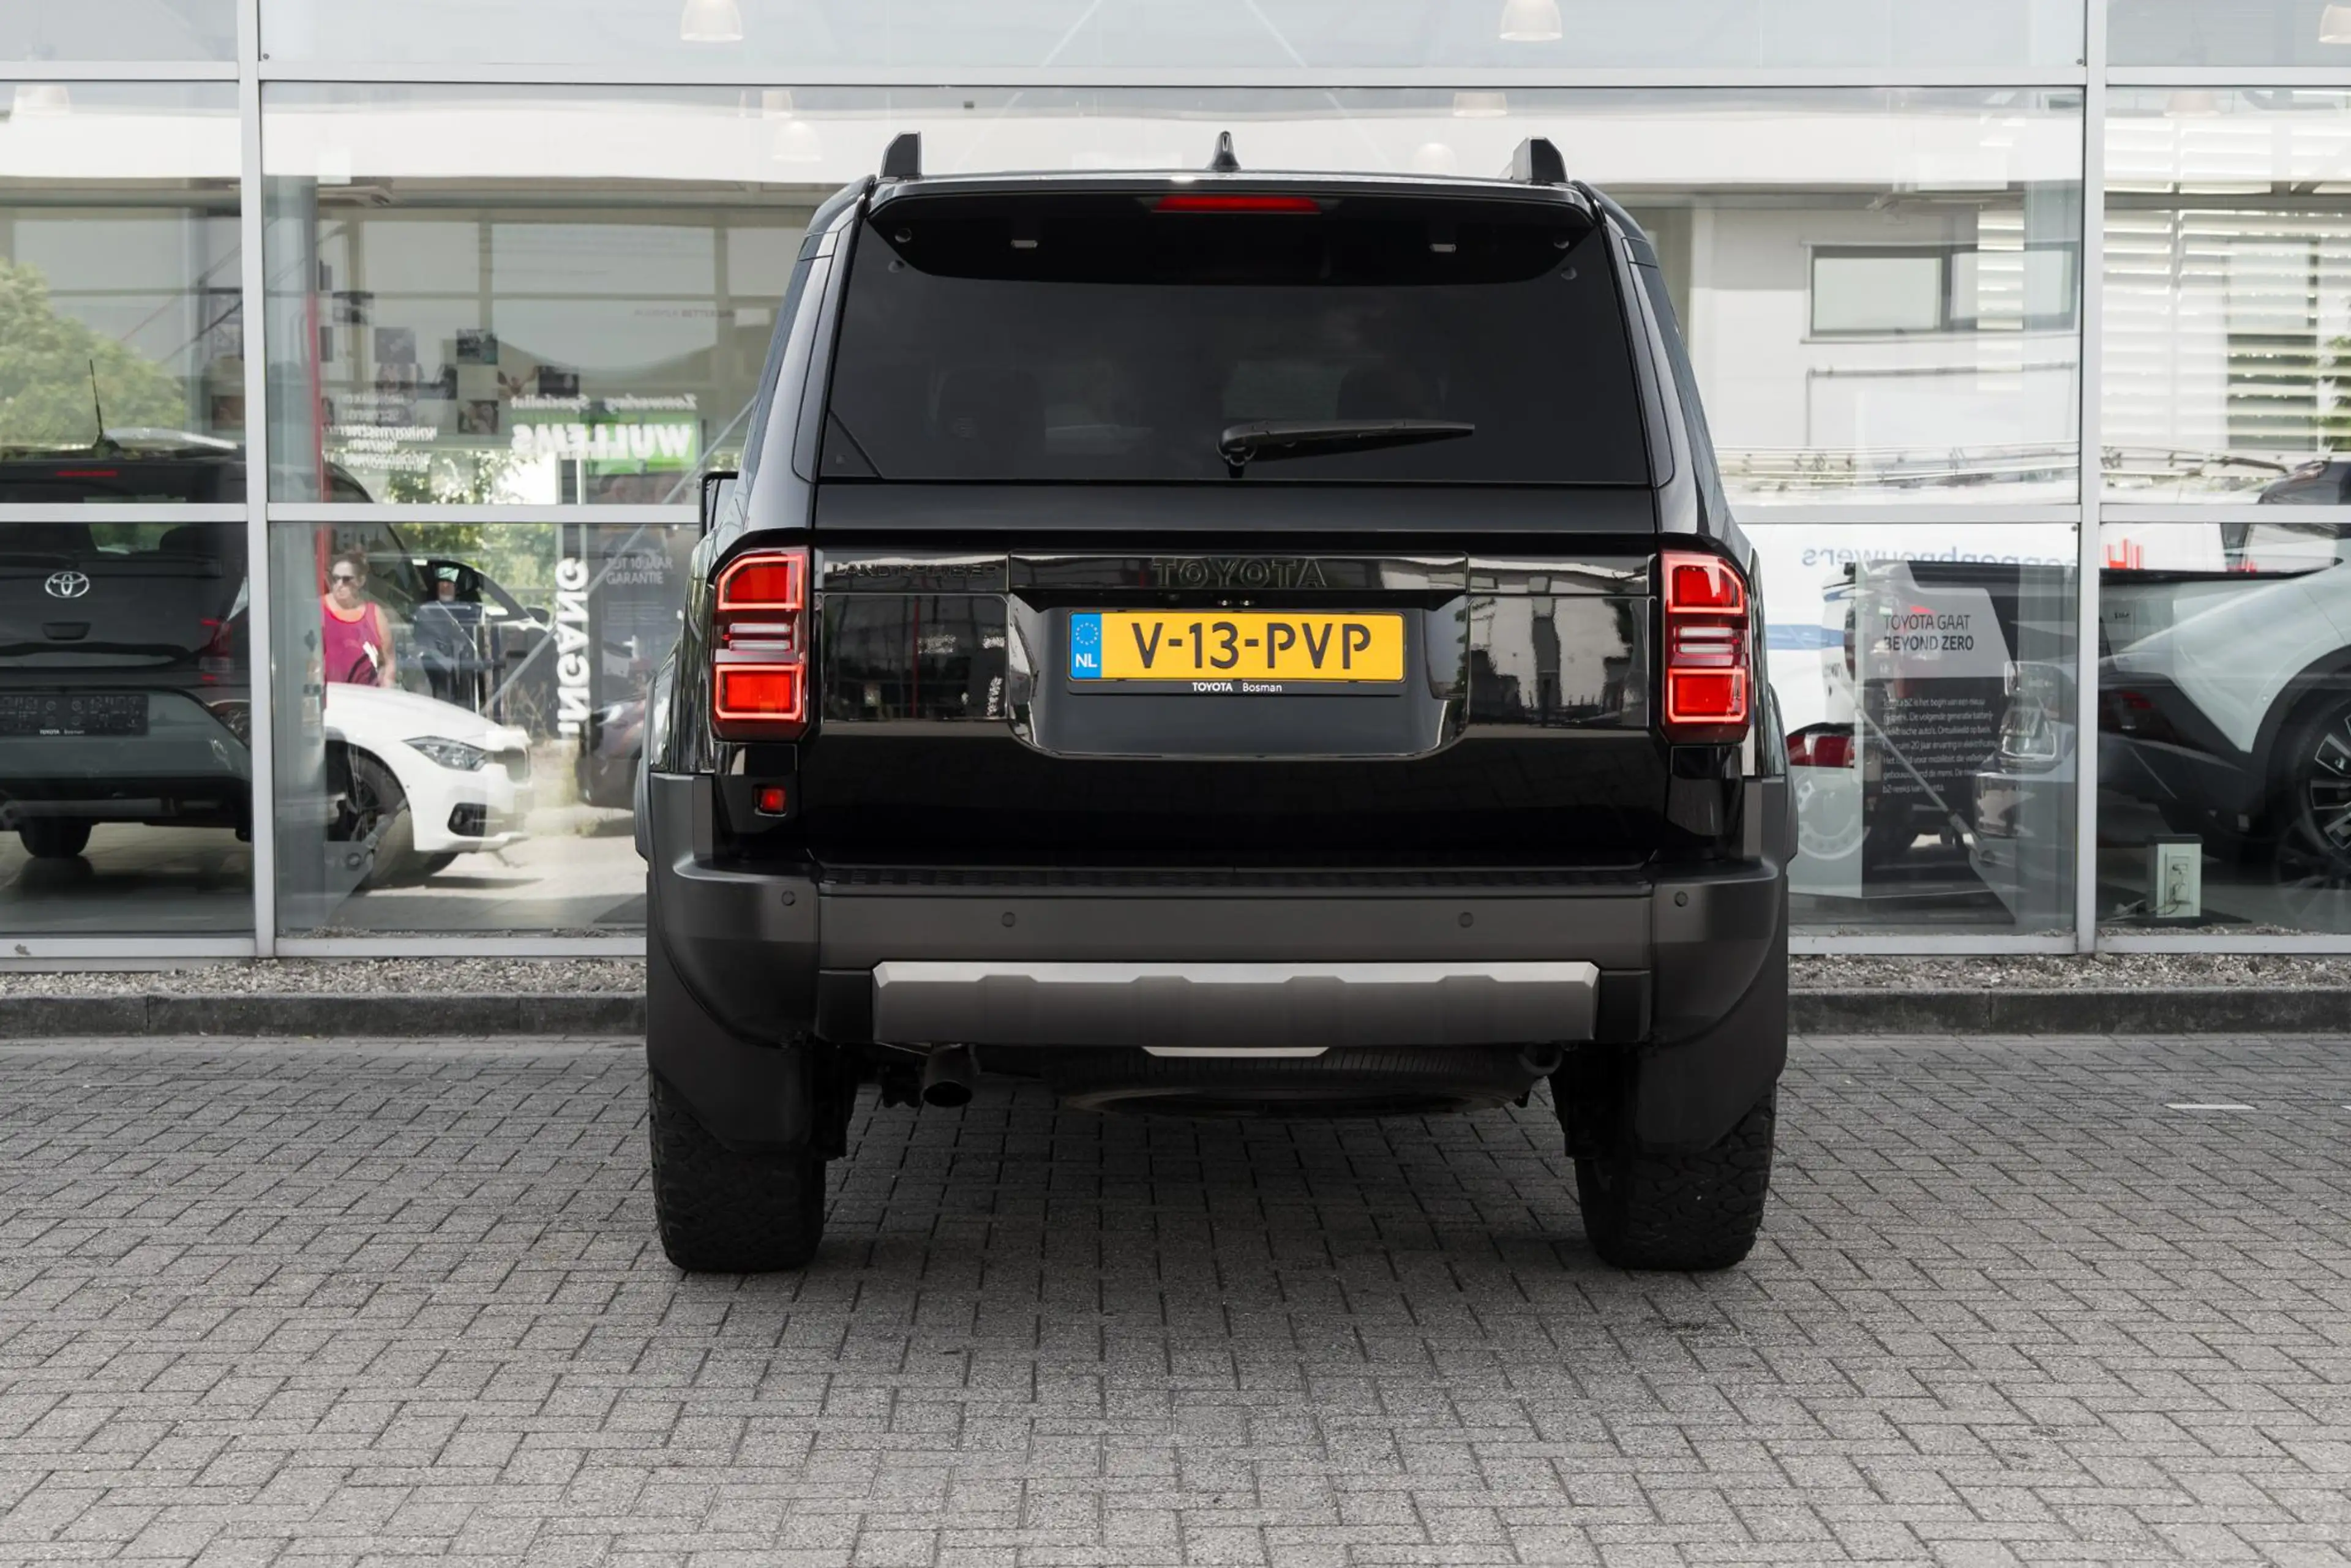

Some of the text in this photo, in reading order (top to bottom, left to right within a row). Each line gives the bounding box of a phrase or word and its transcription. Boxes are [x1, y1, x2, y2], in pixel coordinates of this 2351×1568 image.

[832, 562, 892, 577] LAND
[1151, 557, 1327, 588] TOYOTA
[606, 571, 664, 585] GARANTIE
[1883, 614, 1971, 631] TOYOTA GAAT
[1131, 622, 1372, 669] V-13-PVP
[1883, 635, 1974, 651] BEYOND ZERO
[1075, 654, 1098, 668] NL
[1193, 682, 1283, 692] TOYOTA Bosman
[1911, 741, 1920, 749] 20
